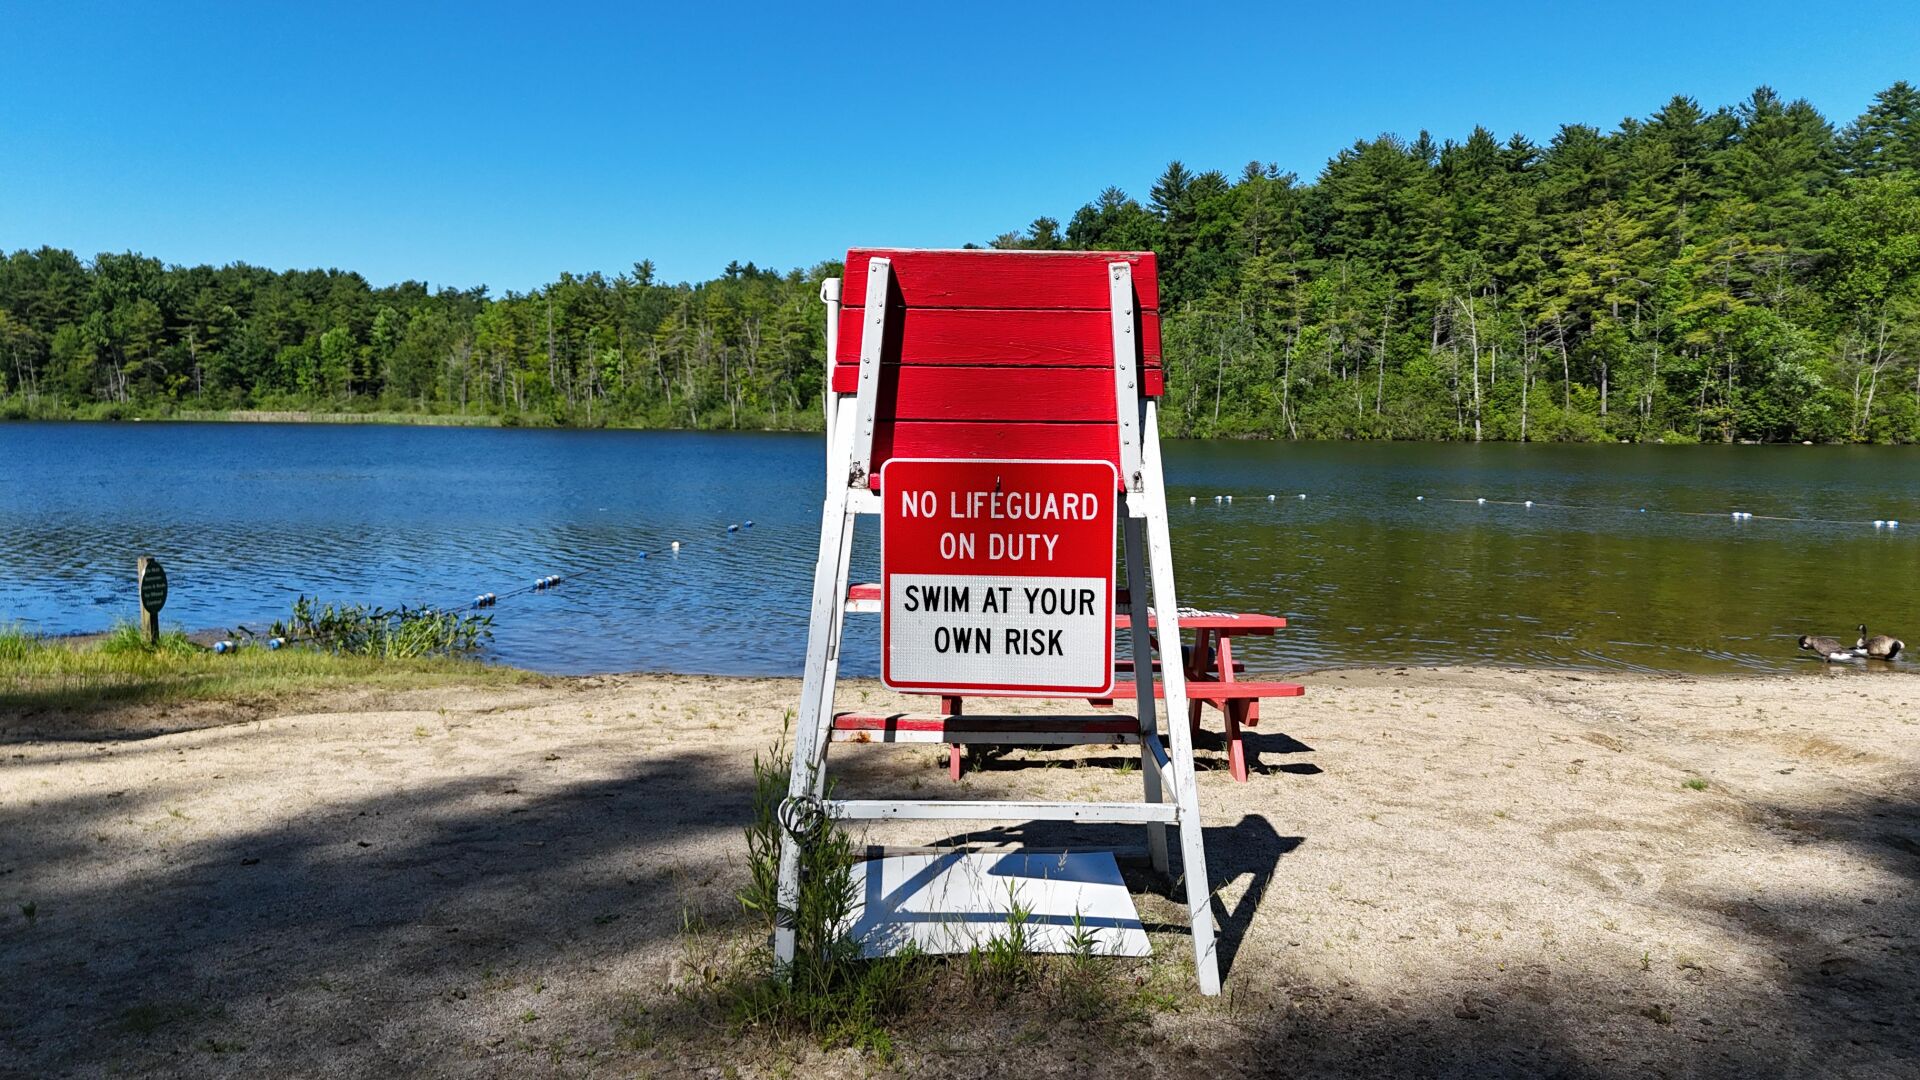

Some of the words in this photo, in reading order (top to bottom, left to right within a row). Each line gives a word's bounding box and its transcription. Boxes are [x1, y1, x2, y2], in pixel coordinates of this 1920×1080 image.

[902, 491, 937, 518] NO
[951, 491, 1098, 520] LIFEGUARD
[940, 532, 975, 559] ON
[990, 534, 1059, 561] DUTY
[904, 585, 969, 612] SWIM
[982, 587, 1012, 613] AT
[1025, 588, 1095, 615] YOUR
[935, 627, 991, 654] OWN
[1006, 629, 1063, 656] RISK
